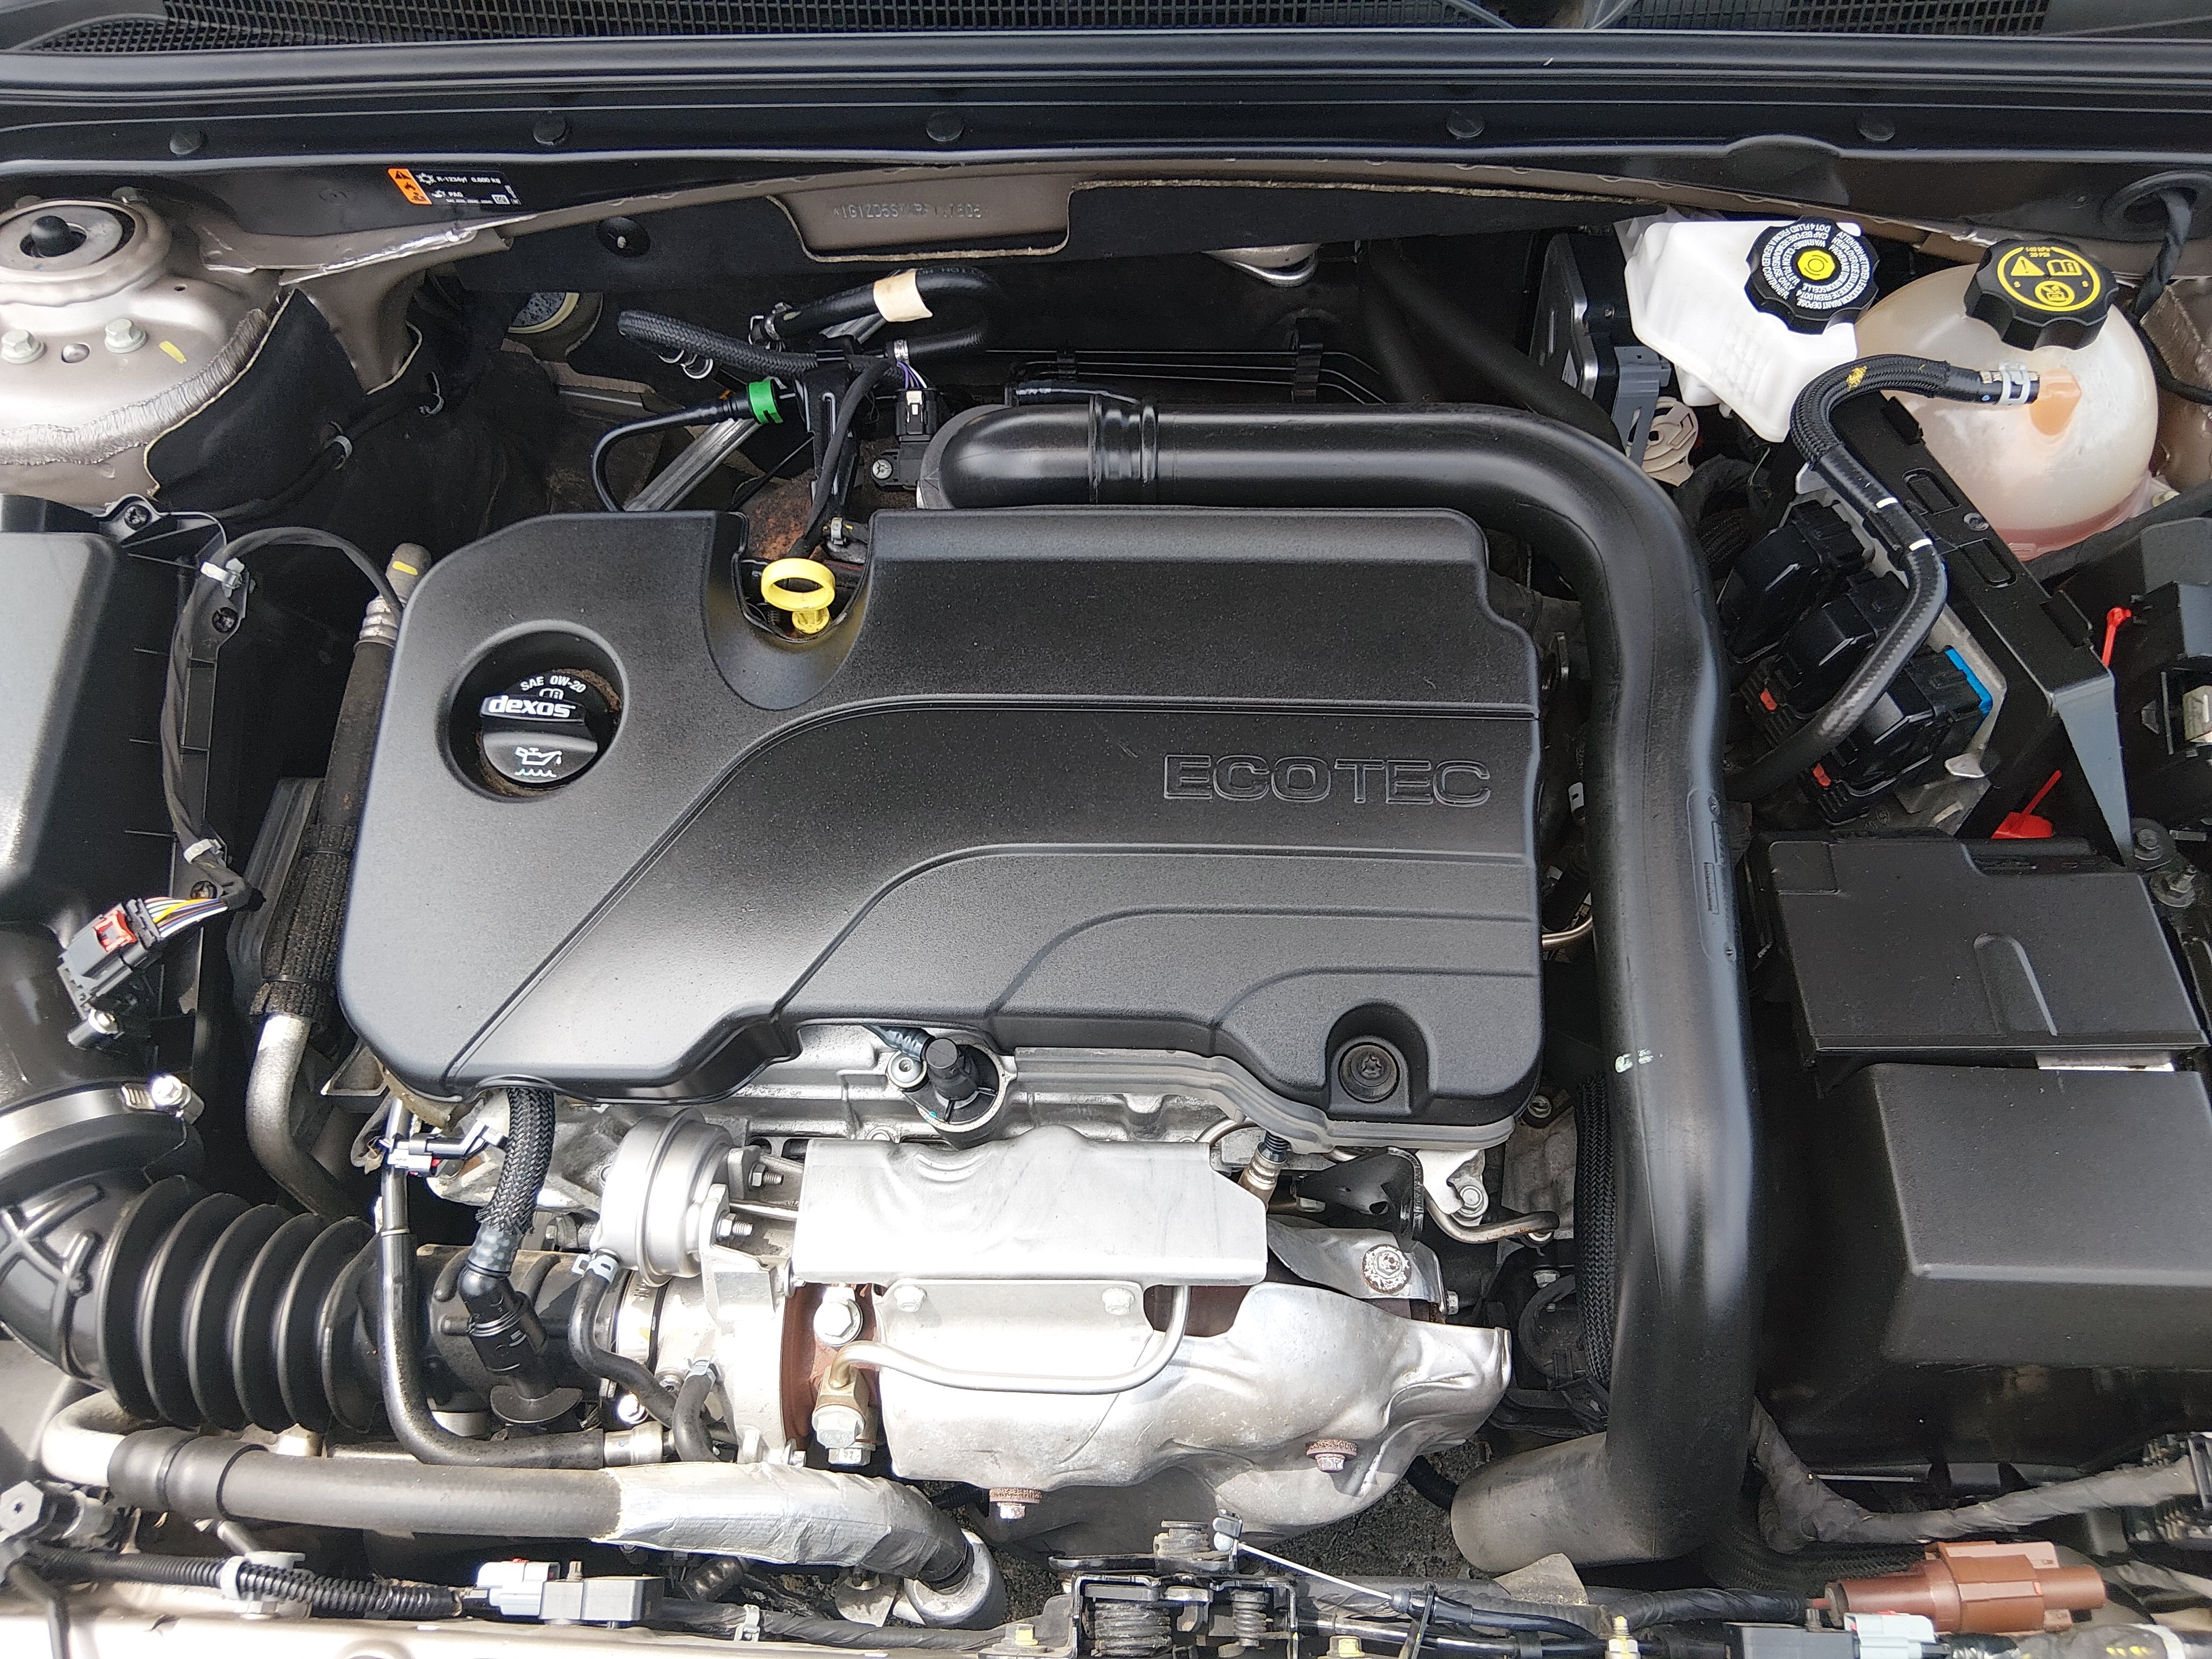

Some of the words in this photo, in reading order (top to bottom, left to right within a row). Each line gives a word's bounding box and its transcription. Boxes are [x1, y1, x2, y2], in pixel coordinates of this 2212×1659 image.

[1771, 228, 1791, 243] FROM
[1789, 222, 1810, 233] FLUID
[1812, 230, 1829, 240] CAP
[1785, 230, 1813, 243] BEFORE
[1761, 243, 1774, 267] SEALED
[1781, 247, 1796, 266] CLEAN
[1771, 266, 1784, 278] USE
[1782, 266, 1800, 286] FILLER
[1776, 276, 1795, 293] ONLY
[1813, 292, 1832, 301] FREIN
[520, 676, 544, 691] SAE
[549, 675, 587, 693] 0W-20
[488, 696, 576, 718] dexos
[1164, 754, 1492, 807] ECOTEC
